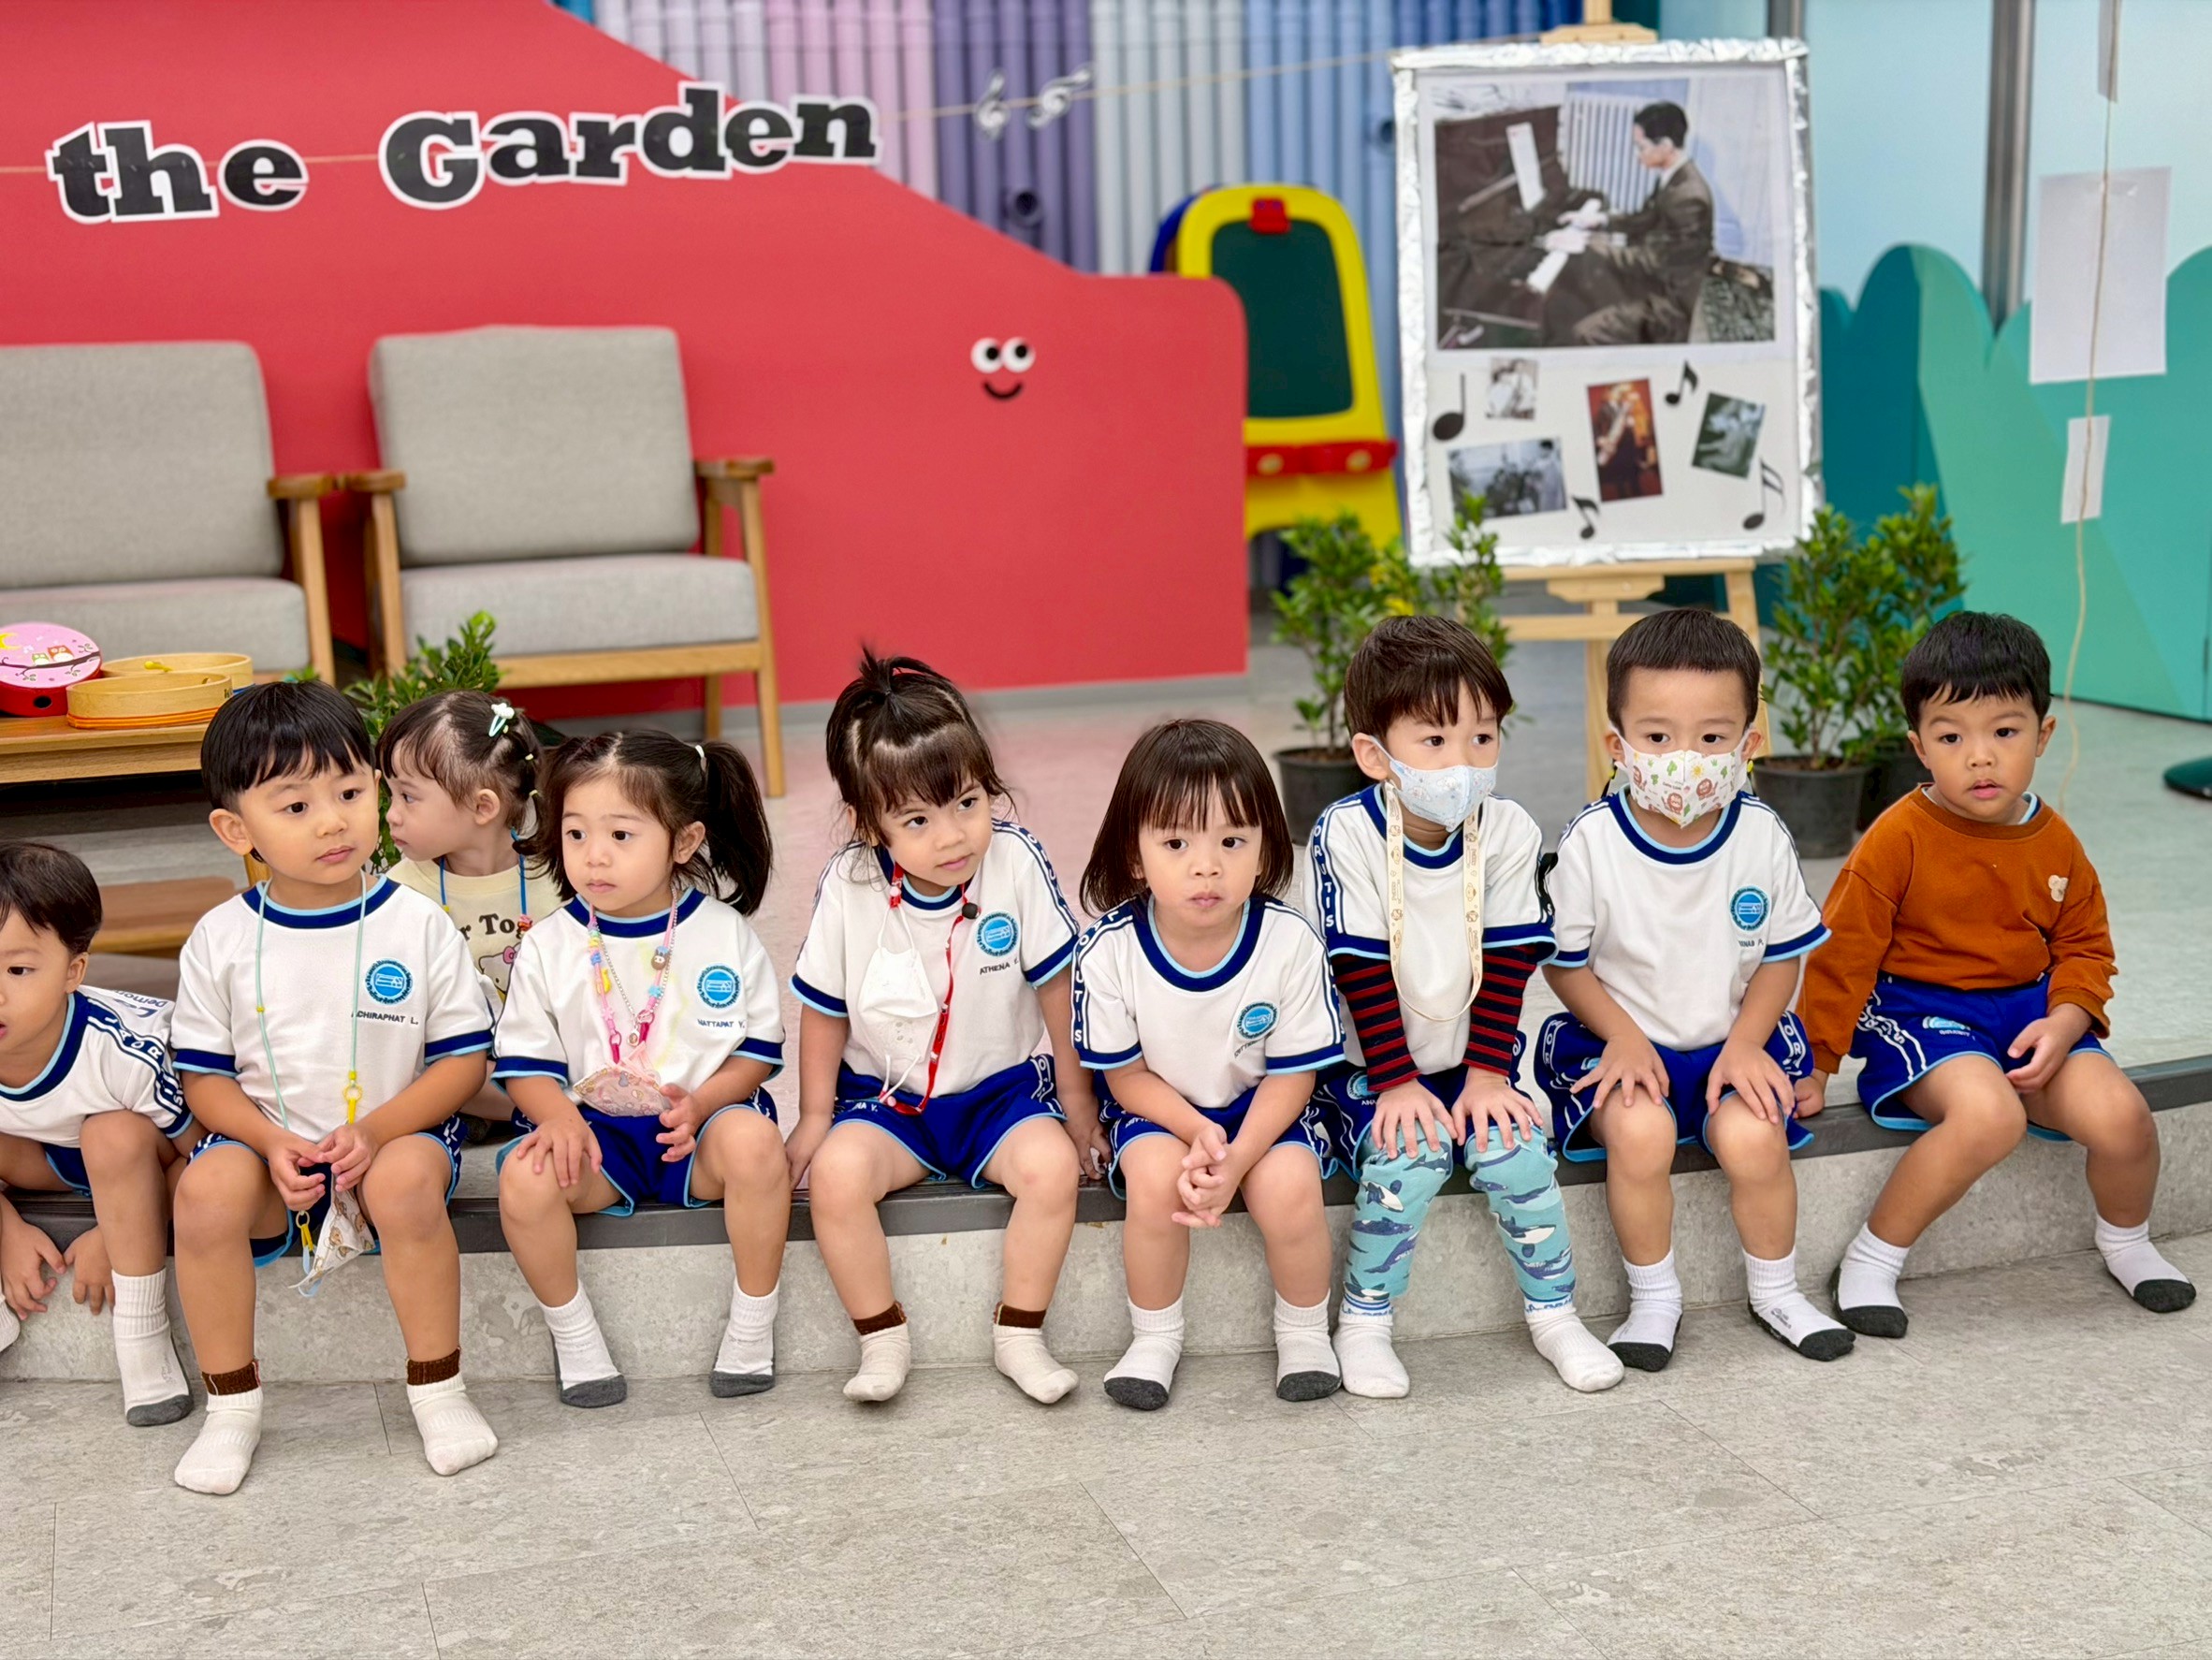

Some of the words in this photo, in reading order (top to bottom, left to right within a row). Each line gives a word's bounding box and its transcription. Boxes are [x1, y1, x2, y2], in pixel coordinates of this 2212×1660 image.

[48, 121, 308, 222] the
[381, 82, 882, 208] Garden
[979, 962, 1011, 975] ATHENA
